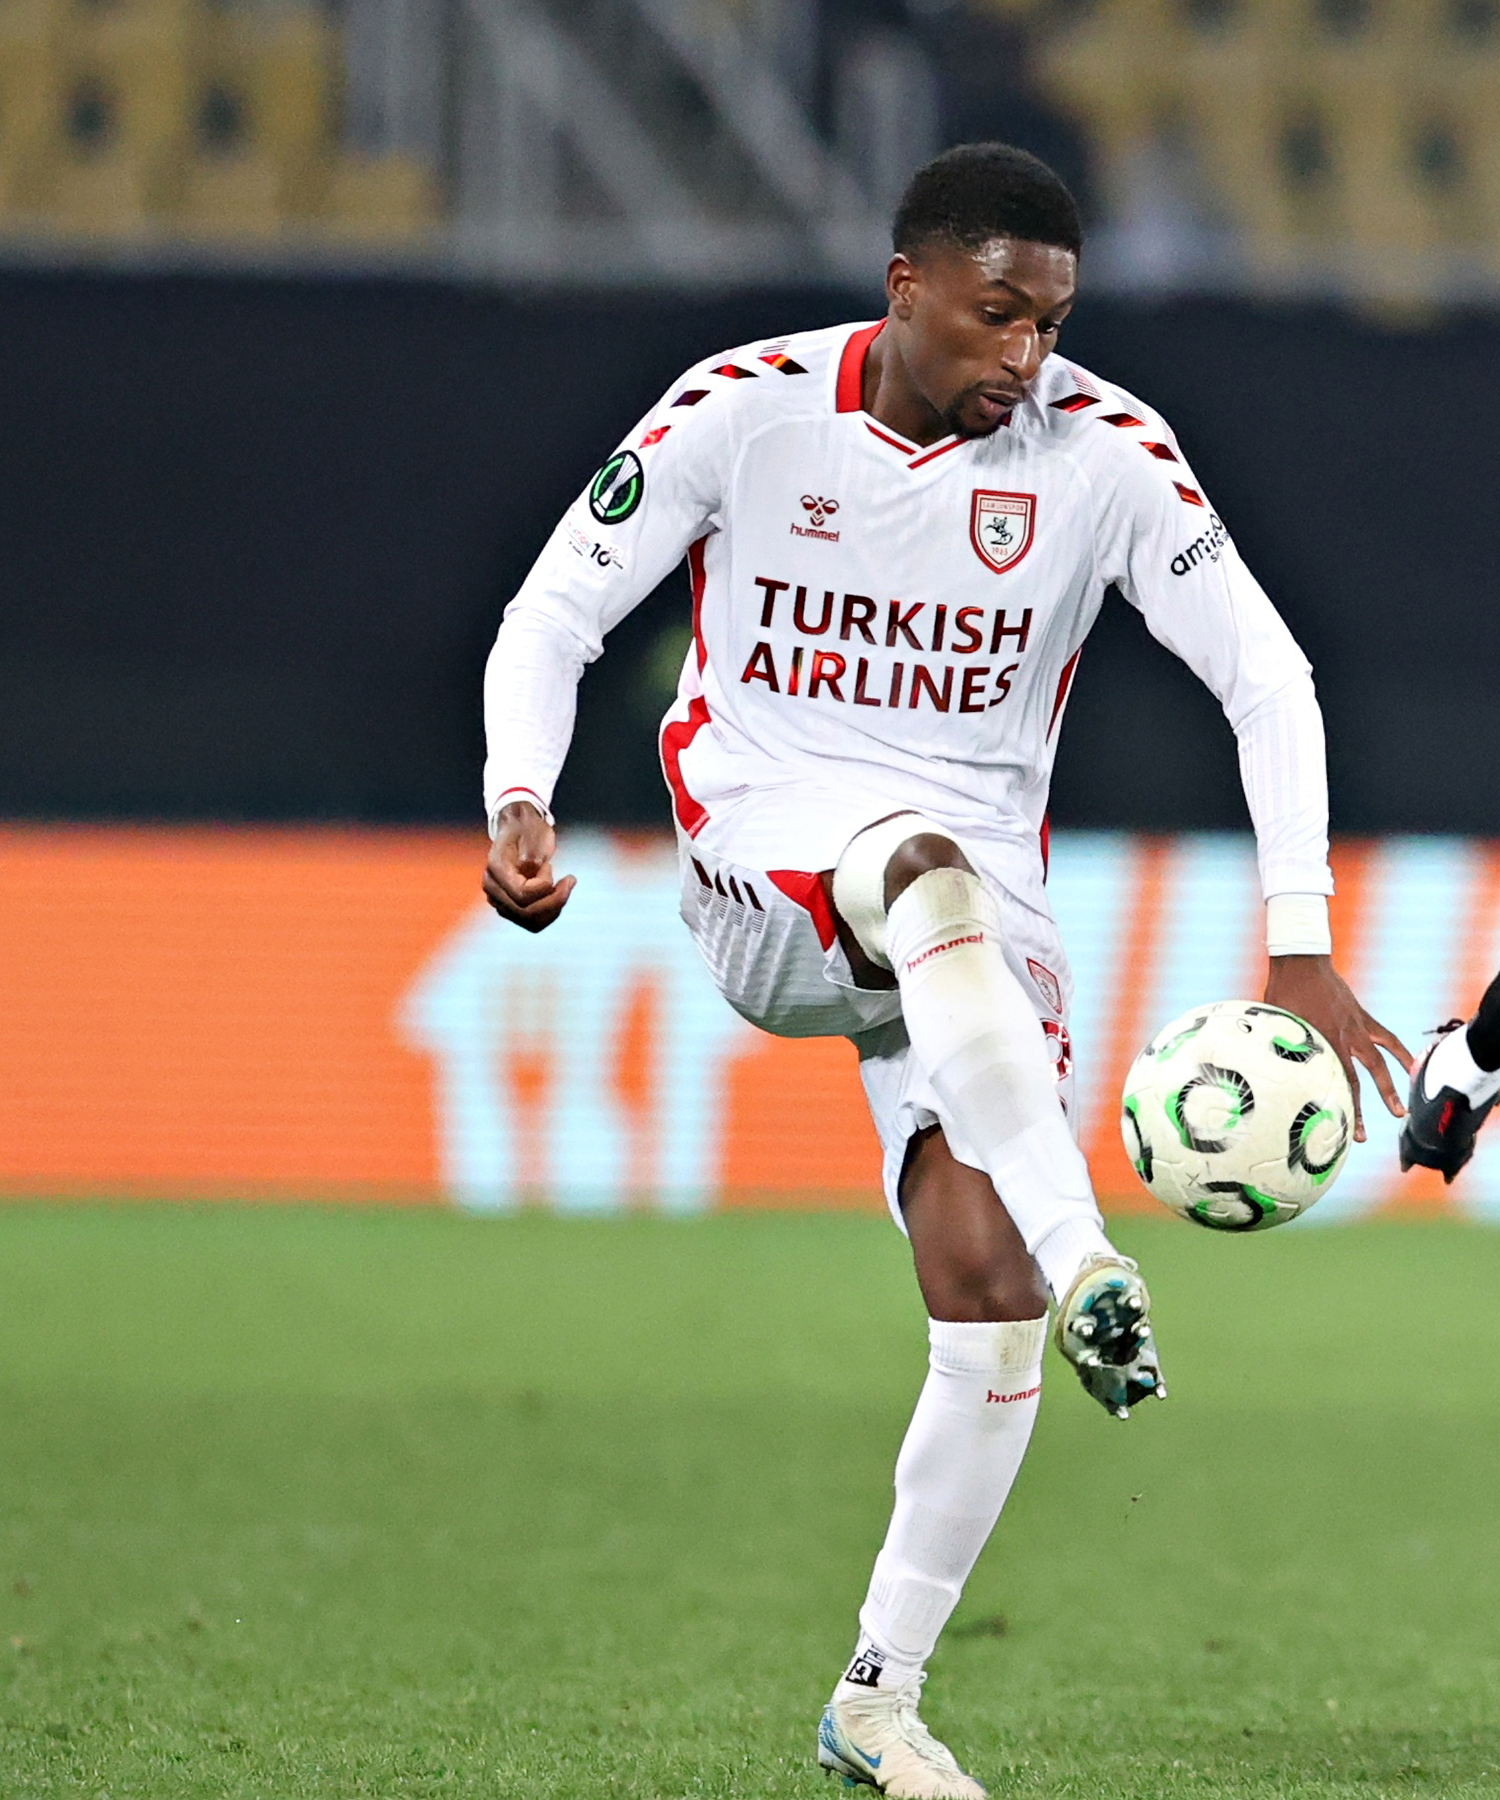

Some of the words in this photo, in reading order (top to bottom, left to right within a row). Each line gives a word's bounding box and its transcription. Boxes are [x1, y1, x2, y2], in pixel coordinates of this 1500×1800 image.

[790, 522, 840, 543] hummel
[754, 576, 1033, 655] TURKISH
[740, 641, 1020, 713] AIRLINES
[906, 932, 984, 973] hummel
